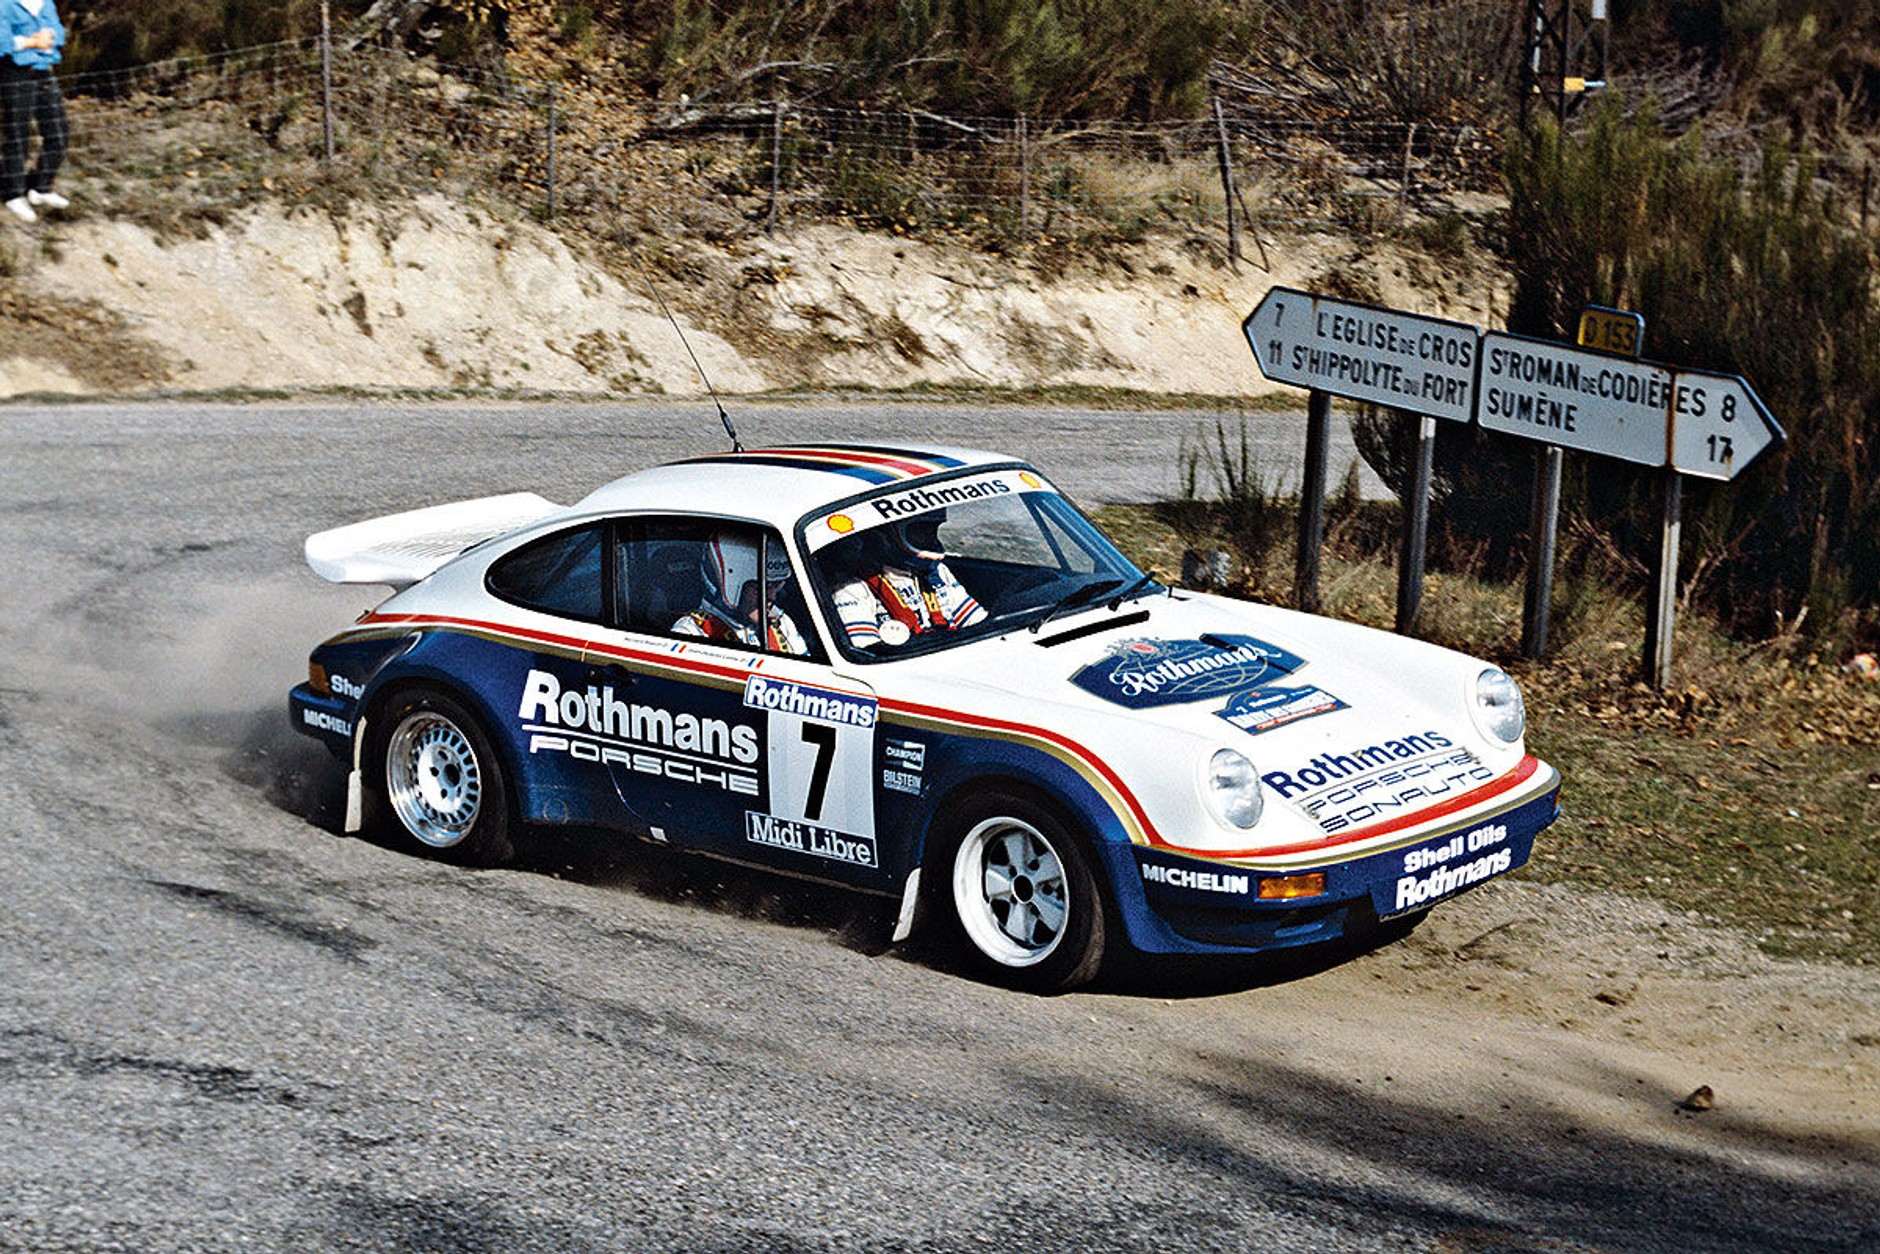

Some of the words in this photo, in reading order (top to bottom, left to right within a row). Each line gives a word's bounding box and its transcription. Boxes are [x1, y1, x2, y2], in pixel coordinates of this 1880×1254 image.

[1275, 302, 1285, 327] 7
[1400, 338, 1416, 356] DE
[1418, 333, 1473, 368] CROS
[1604, 320, 1635, 351] 153
[1269, 340, 1283, 367] 11
[1308, 350, 1404, 394] HIPPOLYTE
[1422, 373, 1469, 407] FORT
[1509, 351, 1580, 391] ROMAN
[1581, 376, 1598, 395] DE
[1721, 393, 1737, 423] 8
[1487, 387, 1578, 432] SUMÈNE
[1707, 434, 1734, 464] 17
[872, 475, 1011, 520] Rothmans
[1109, 643, 1283, 696] Rothmans
[519, 669, 760, 763] Rothmans
[746, 677, 875, 727] Rothmans
[530, 735, 760, 796] PORSCHE
[801, 721, 837, 821] 7
[1261, 730, 1454, 799] Rothmans
[1306, 752, 1474, 816] PORSCHE
[1320, 766, 1494, 833] SONAUTO
[751, 815, 803, 850] Midi
[809, 827, 872, 863] Libre
[1404, 837, 1464, 873] Shell
[1468, 825, 1507, 855] Oils
[1142, 863, 1249, 894] MICHELIN
[1396, 848, 1511, 910] Rothmans
